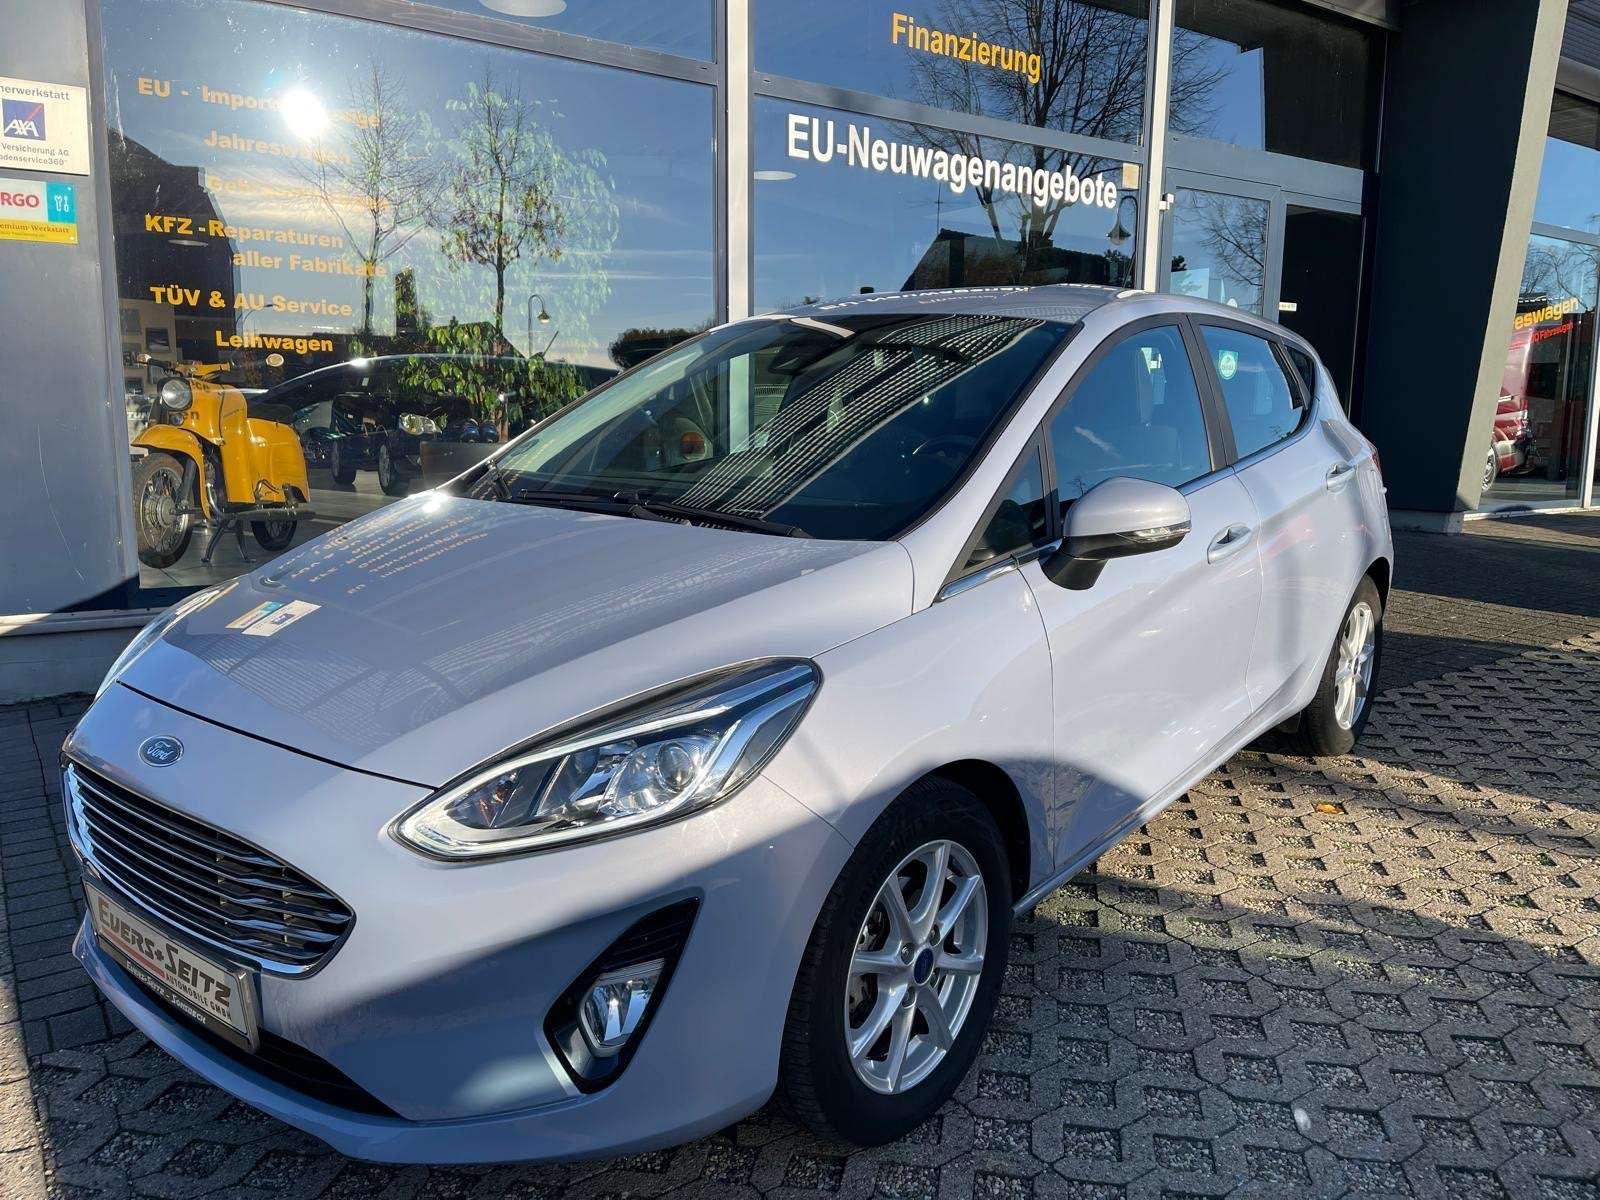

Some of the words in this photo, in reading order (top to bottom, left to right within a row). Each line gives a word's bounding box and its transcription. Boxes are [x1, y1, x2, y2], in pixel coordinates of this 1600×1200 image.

[890, 11, 1042, 85] Finanzierung
[137, 76, 171, 98] EU
[5, 119, 40, 137] AXA
[58, 149, 69, 157] AG
[787, 113, 1118, 209] EU-Neuwagenangebote
[0, 192, 40, 208] RGO
[145, 214, 193, 235] KFZ
[208, 219, 344, 248] Reparaturen
[233, 251, 282, 269] aller
[289, 255, 387, 277] Fabrikate
[150, 284, 200, 307] TÜV
[209, 290, 226, 308] &
[234, 293, 265, 311] AU
[272, 295, 353, 317] Service
[1513, 296, 1579, 330] eswagen
[215, 330, 334, 354] Leihwagen
